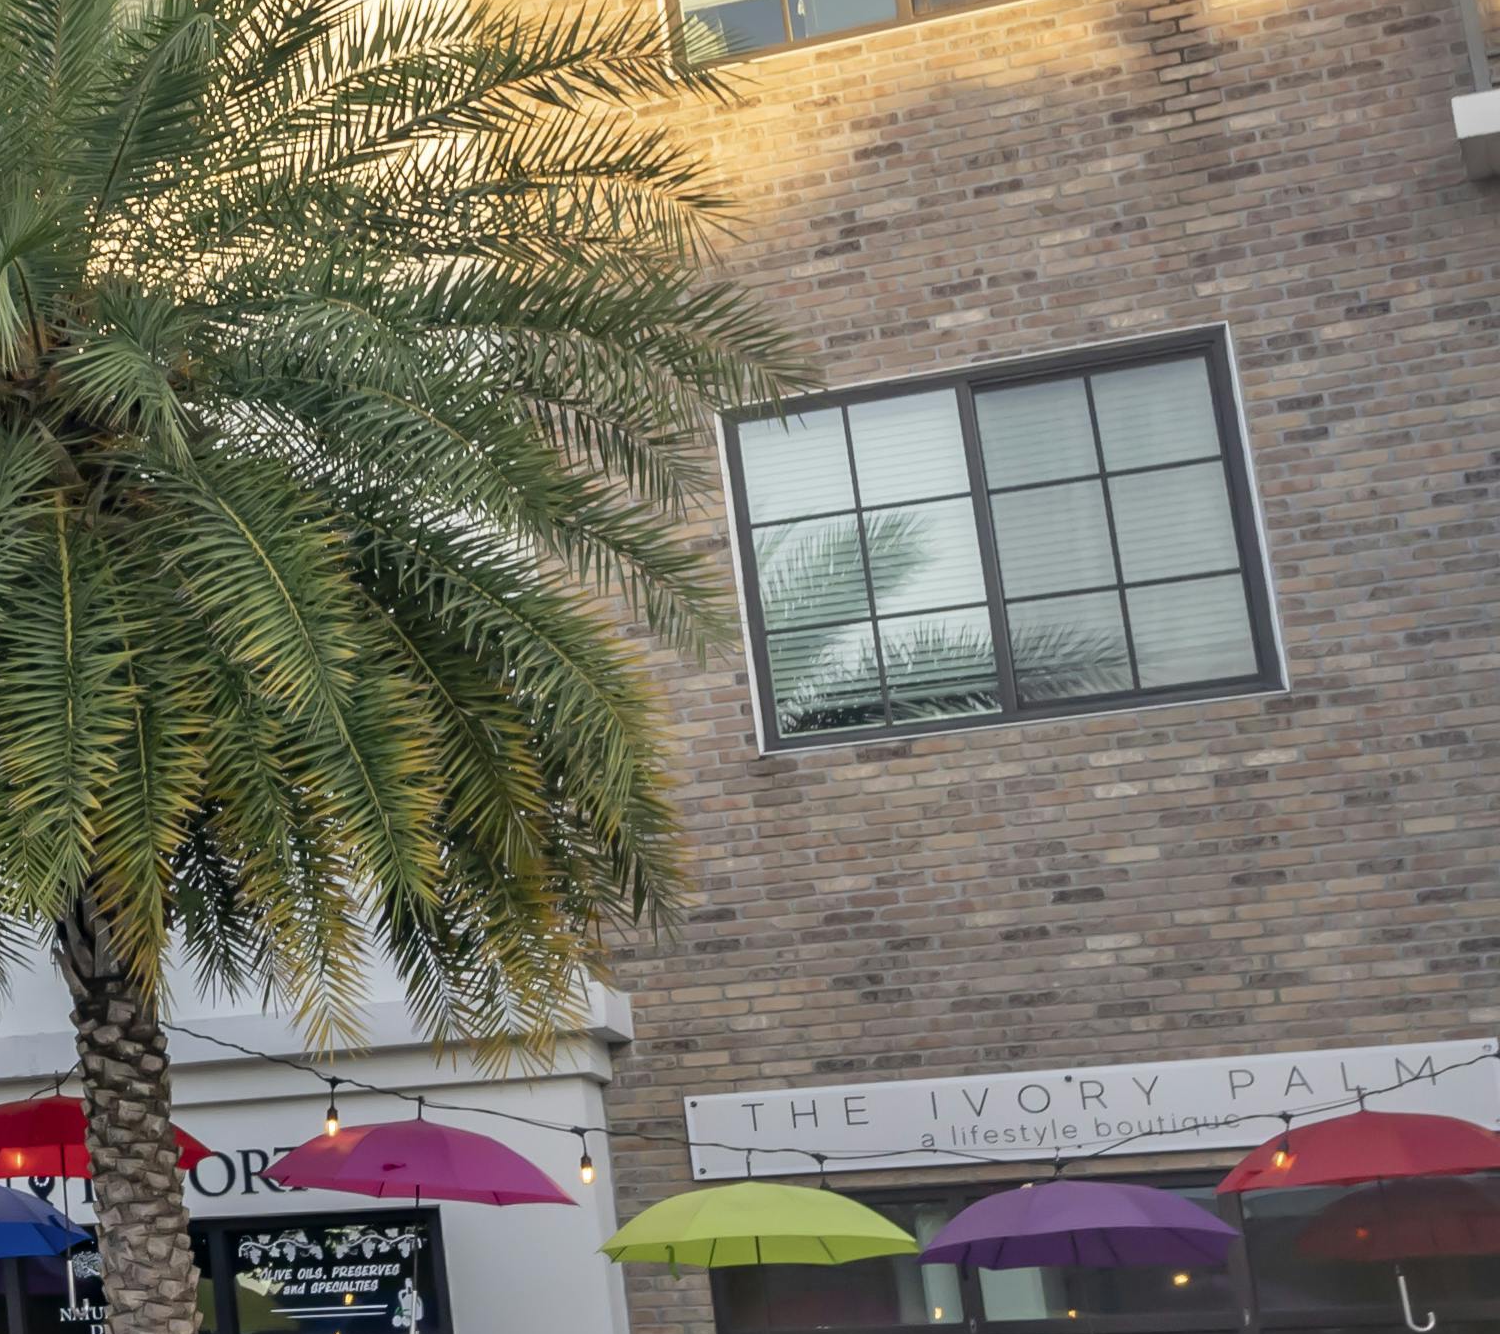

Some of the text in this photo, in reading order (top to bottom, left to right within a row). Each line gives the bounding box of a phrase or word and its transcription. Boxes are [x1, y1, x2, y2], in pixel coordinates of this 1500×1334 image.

[742, 1056, 1437, 1131] THE IVORY PALM
[921, 1112, 1241, 1148] a lifestyle boutique
[259, 1268, 292, 1280] OLIVE
[332, 1264, 400, 1278] PRESERVES
[283, 1279, 378, 1295] and SPECIALTIES
